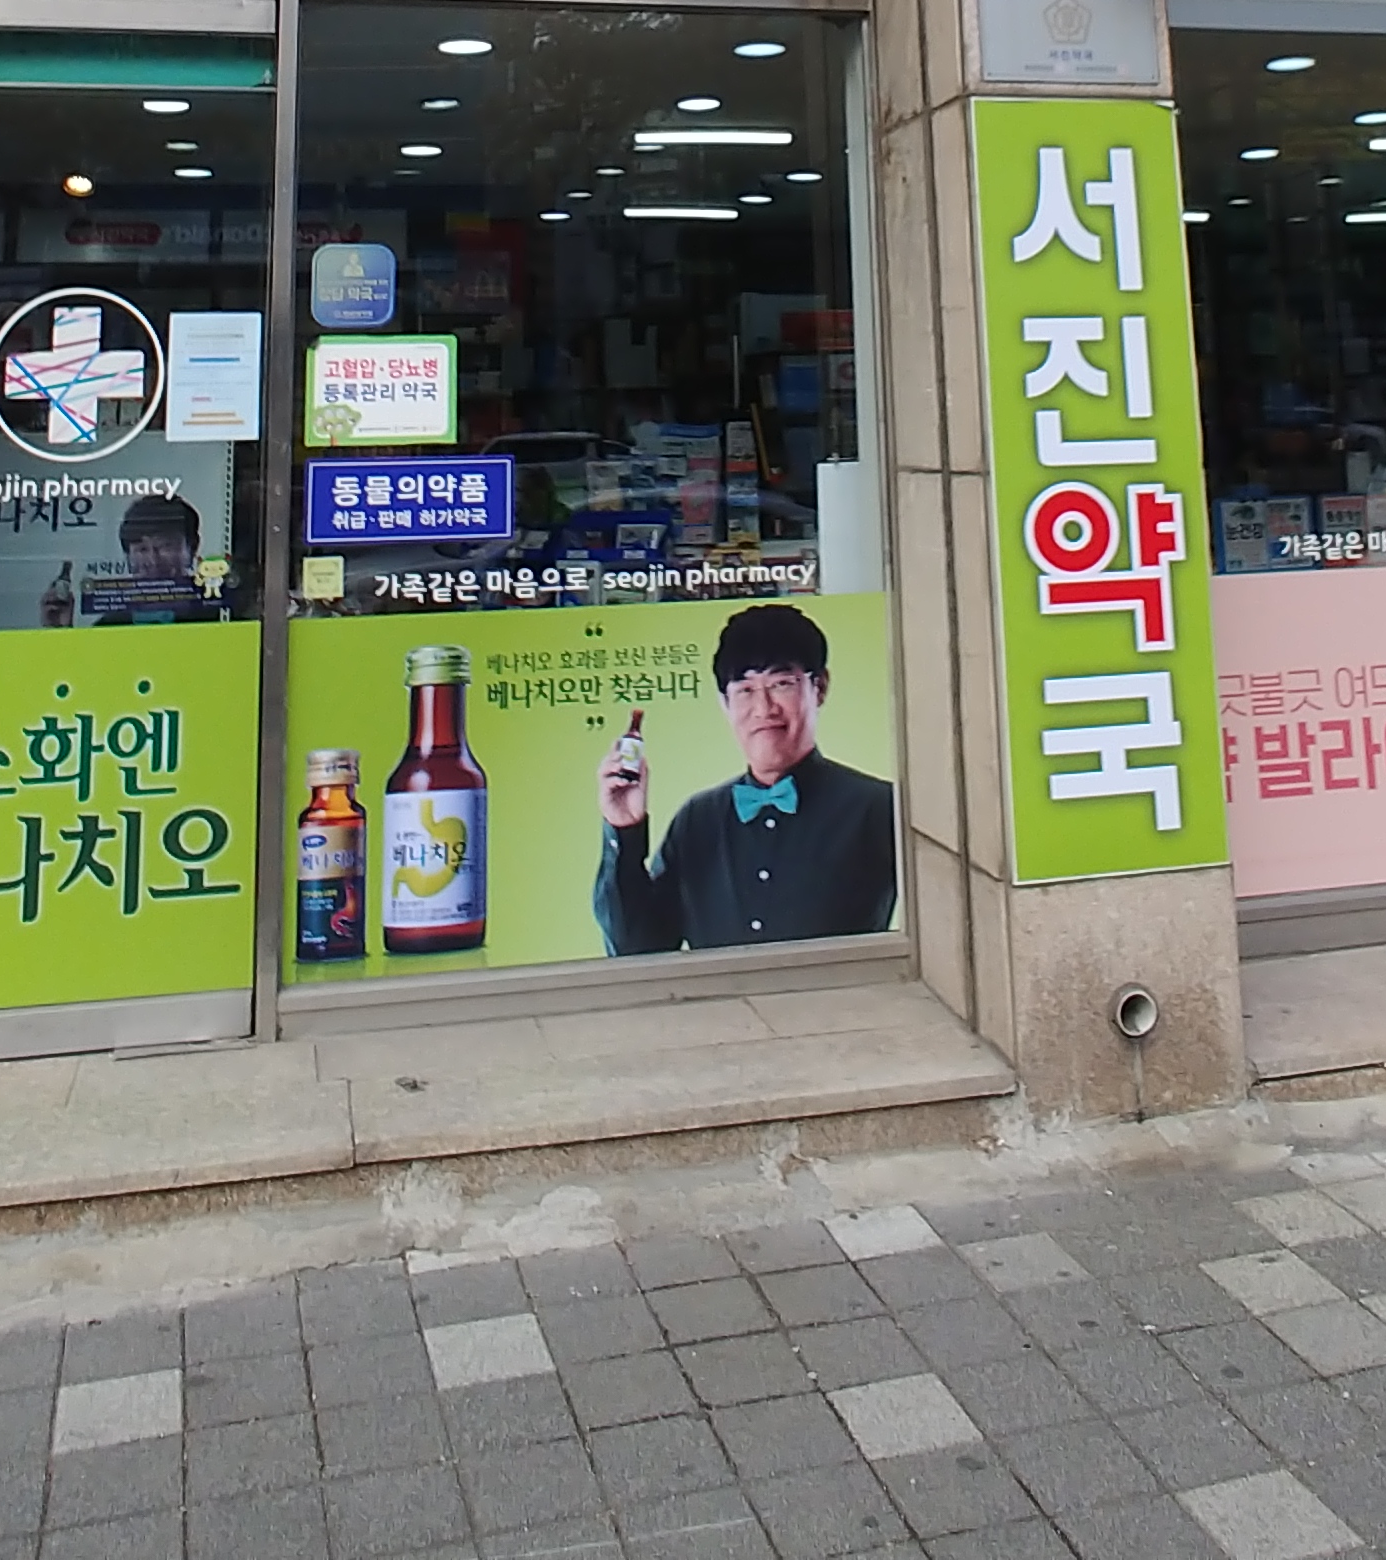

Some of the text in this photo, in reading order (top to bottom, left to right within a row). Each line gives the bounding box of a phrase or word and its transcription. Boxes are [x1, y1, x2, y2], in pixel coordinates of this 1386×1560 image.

[324, 382, 438, 404] 등록관리 약국
[43, 473, 182, 501] pharmacy
[331, 474, 488, 507] 동물의약품
[1013, 146, 1186, 831] 서진약국
[419, 507, 488, 527] 허가약국
[1278, 531, 1364, 561] 가족같은
[374, 560, 816, 604] 가족같은 마음으로 seojin pharmacy
[486, 643, 701, 674] 베나치오 효과를 보신 분들은
[486, 669, 701, 709] 베나치오만 찾습니다
[1218, 668, 1324, 717] 긋불긋
